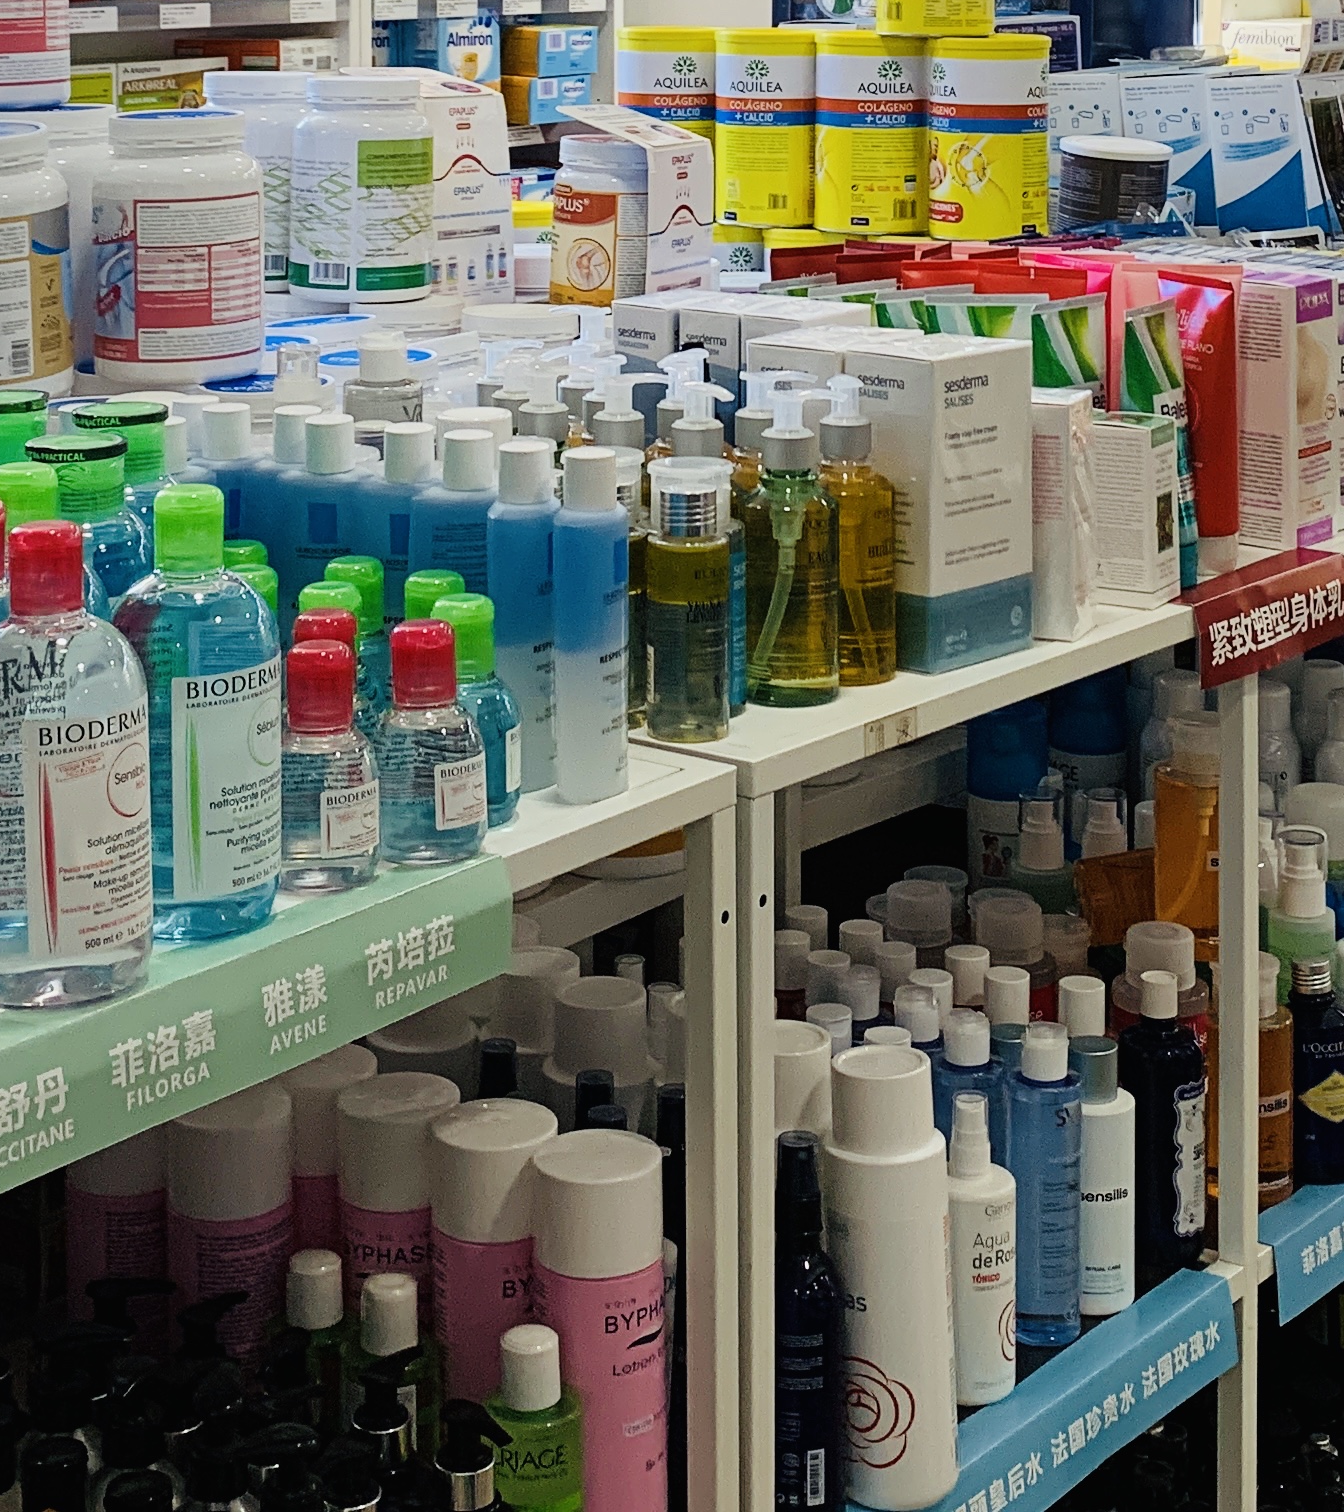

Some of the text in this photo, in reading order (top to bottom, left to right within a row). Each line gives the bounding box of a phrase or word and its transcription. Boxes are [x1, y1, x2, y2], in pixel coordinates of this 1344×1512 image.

[446, 32, 494, 48] Almirón
[1231, 29, 1295, 51] femibion
[653, 76, 709, 90] AQUILEA
[729, 80, 784, 95] AQUILEA
[857, 81, 915, 96] AQUILEA
[653, 93, 708, 107] COLÁGENO
[729, 97, 784, 112] COLÁGENO
[857, 99, 914, 114] COLÁGENO
[745, 111, 775, 123] CALCIO
[876, 113, 907, 125] CALCIO
[618, 329, 656, 342] sesderma
[944, 373, 990, 394] sesderma
[186, 655, 283, 701] BIODERMA
[38, 703, 148, 748] BIODERMA
[374, 964, 450, 1010] REPAVAR
[260, 964, 329, 1029] 雅漾
[268, 1014, 328, 1056] AVENE
[108, 1009, 217, 1091] 菲洛嘉
[124, 1062, 212, 1112] FILORGA
[971, 1230, 1011, 1252] Agua
